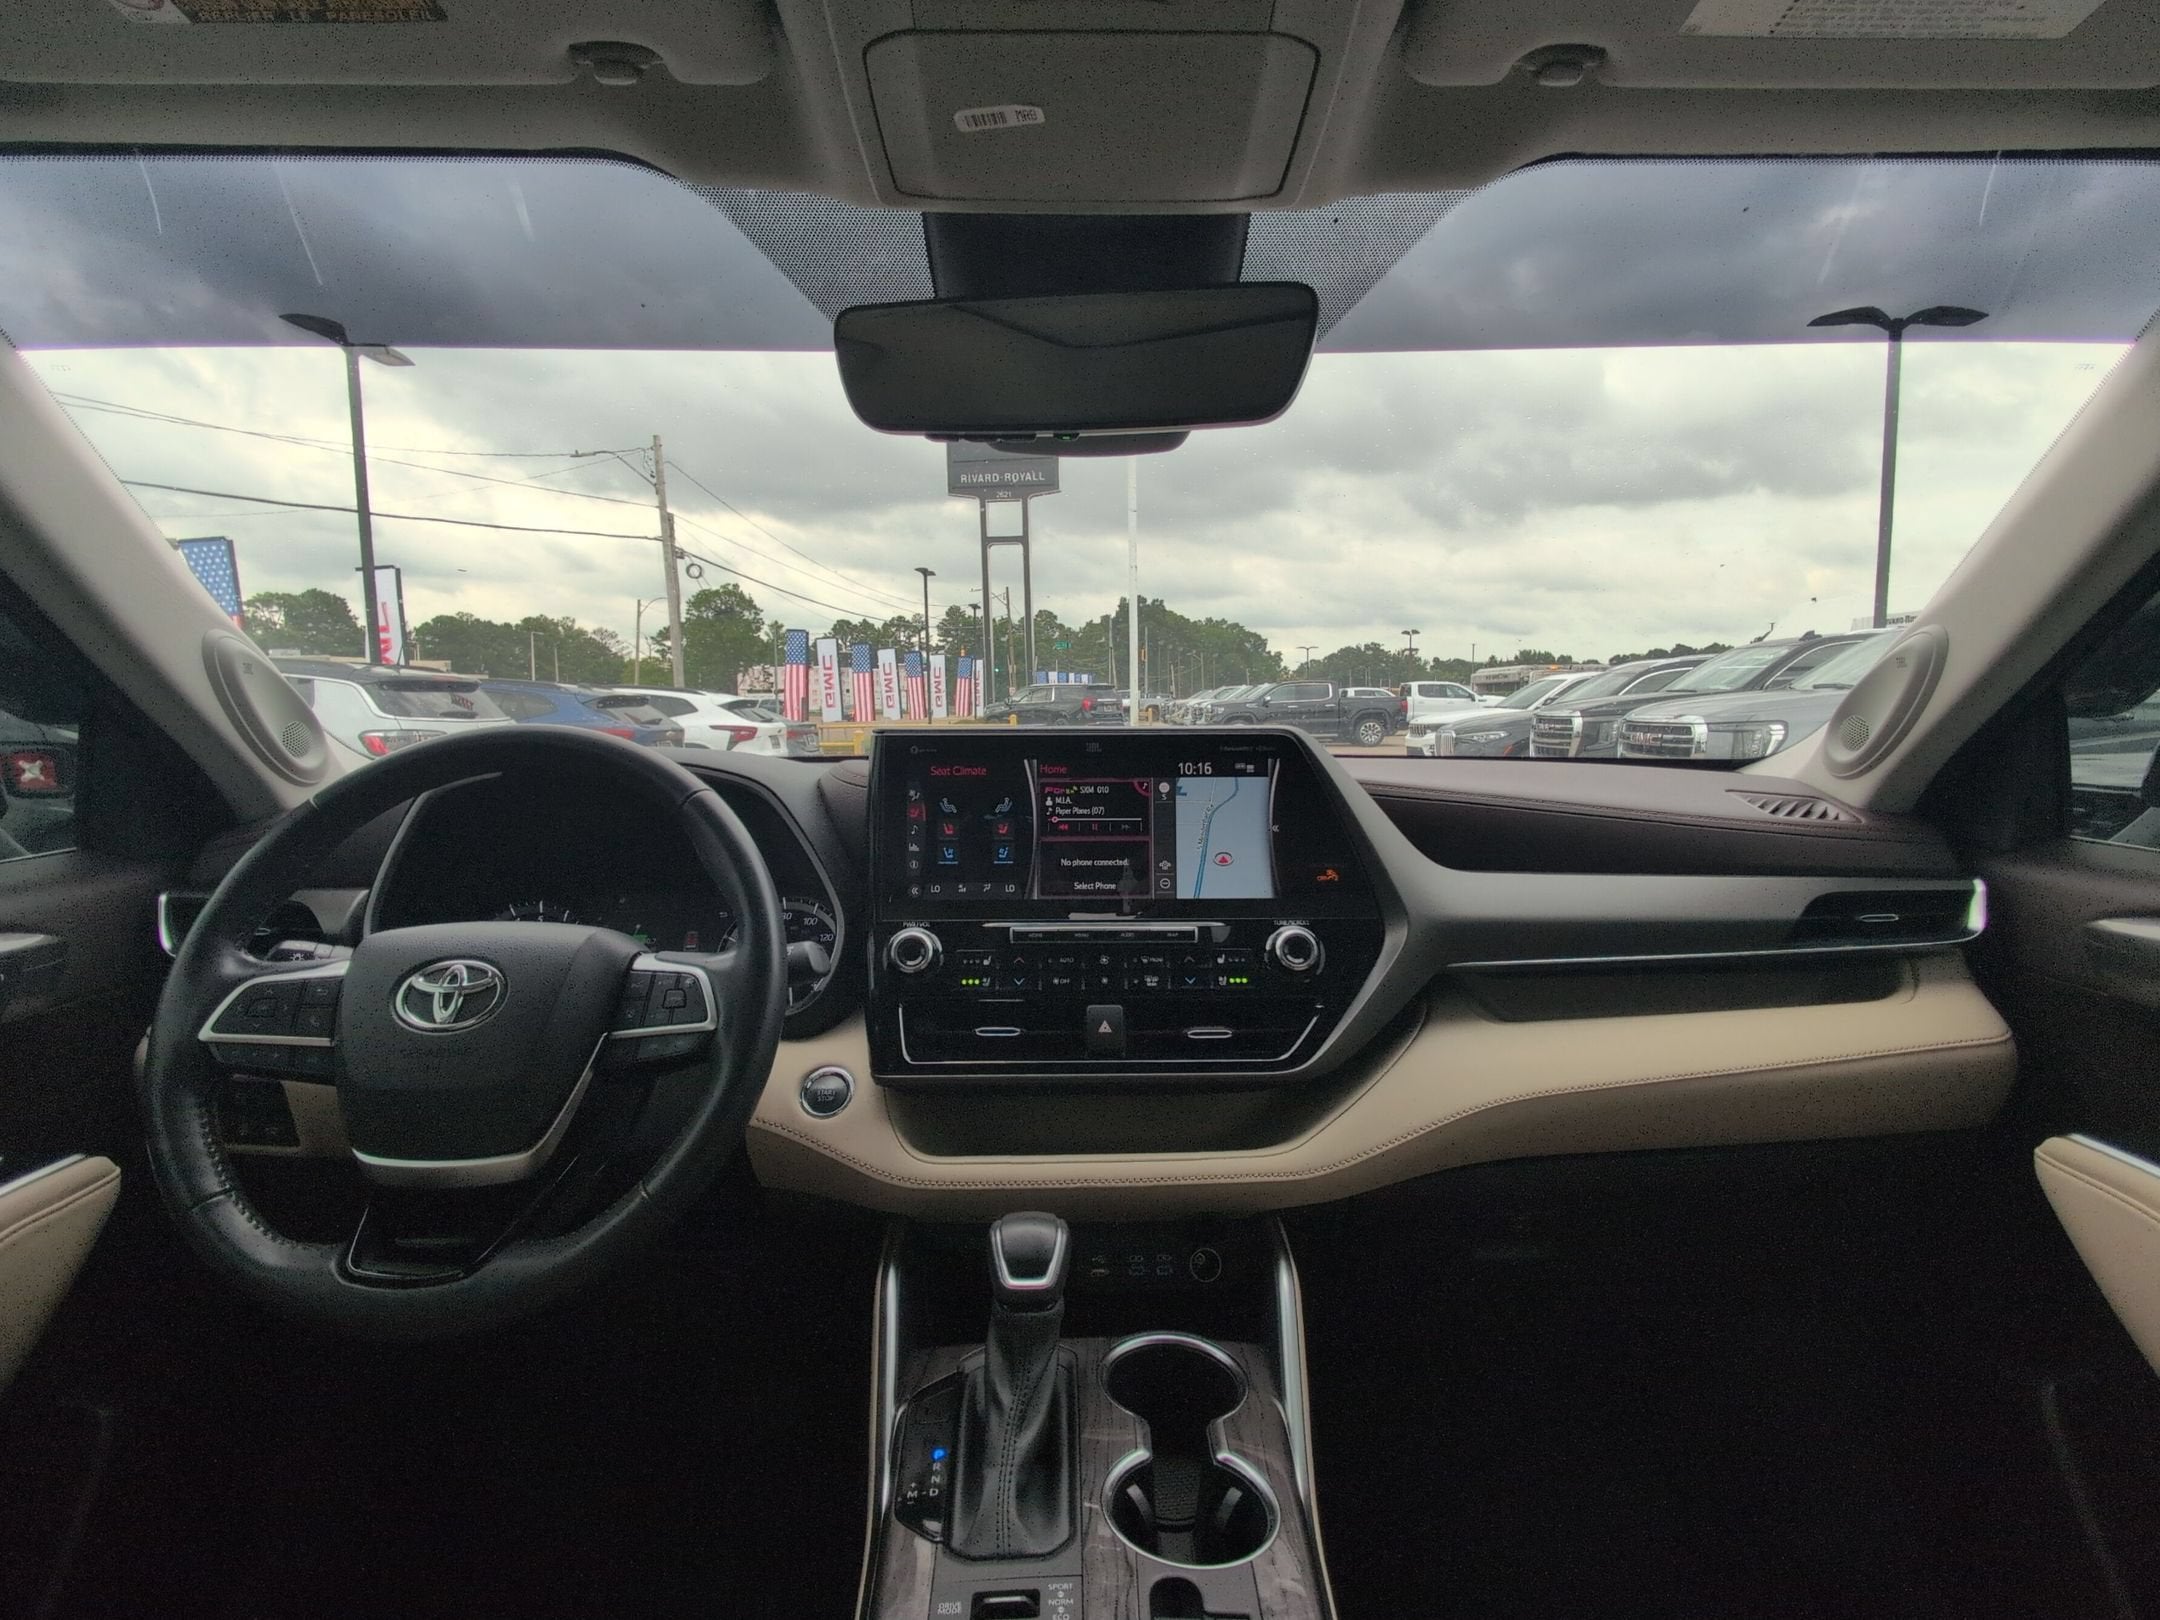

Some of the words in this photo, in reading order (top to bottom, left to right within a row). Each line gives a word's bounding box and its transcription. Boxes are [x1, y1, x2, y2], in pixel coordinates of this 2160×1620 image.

[959, 471, 1045, 483] RIVARD-ROYALL
[930, 766, 951, 776] Seat
[952, 766, 987, 776] Climate
[1039, 764, 1068, 775] Home
[1177, 762, 1213, 775] 10:16
[1097, 785, 1109, 794] 010
[1055, 807, 1071, 816] Paper
[1060, 858, 1071, 866] No
[1072, 858, 1093, 867] phone
[930, 885, 941, 893] LO
[1005, 884, 1016, 893] LO
[1073, 881, 1094, 890] Select
[1095, 881, 1116, 890] Phone
[803, 917, 818, 926] 100
[819, 933, 834, 942] 120
[931, 1475, 941, 1484] N
[906, 1490, 918, 1499] M
[929, 1488, 939, 1497] D
[1047, 1583, 1074, 1591] SPORT
[1048, 1598, 1074, 1606] NORM
